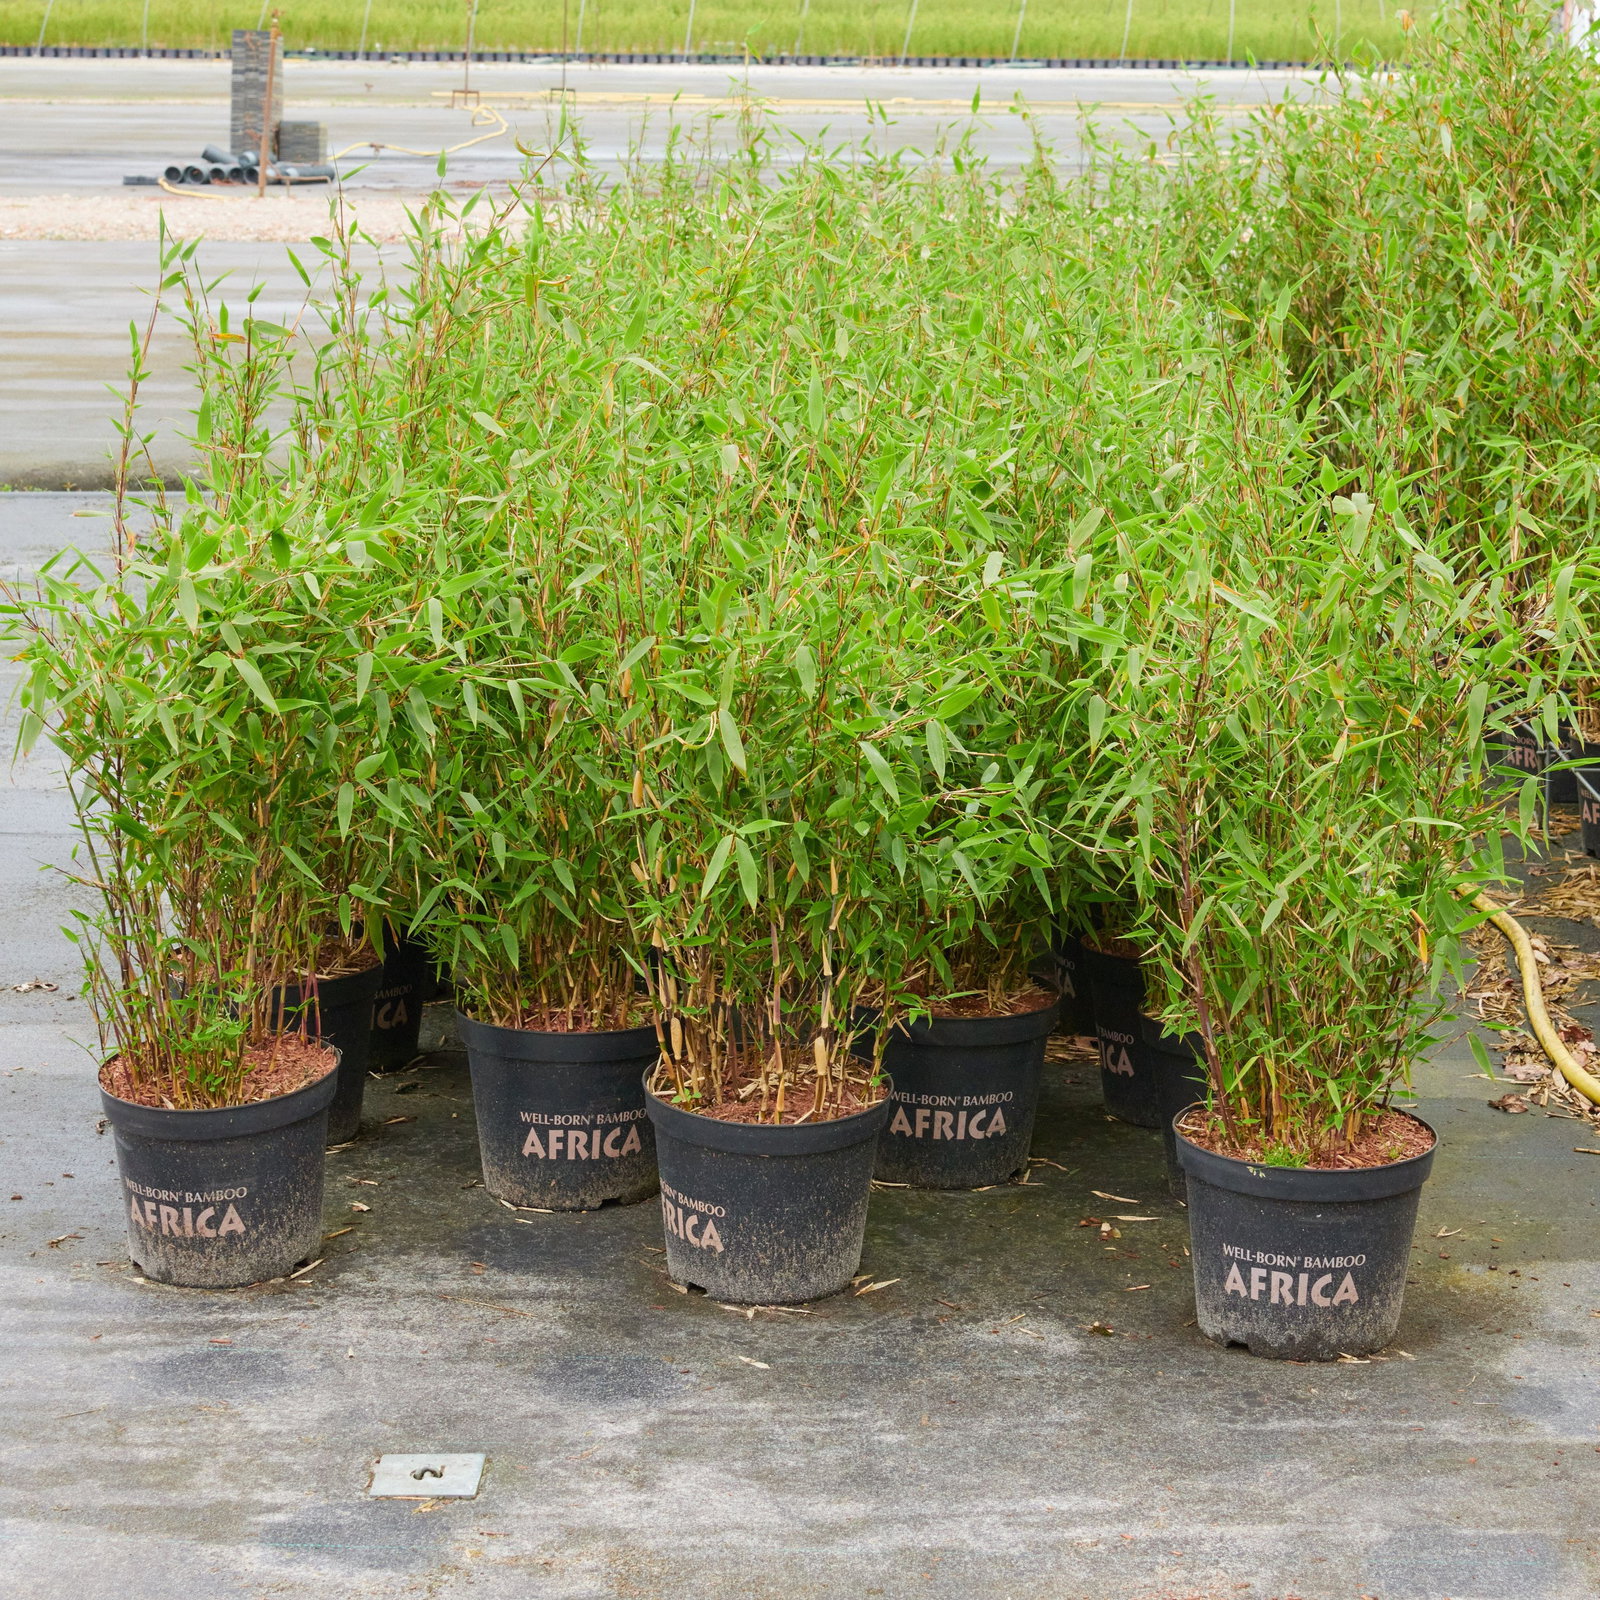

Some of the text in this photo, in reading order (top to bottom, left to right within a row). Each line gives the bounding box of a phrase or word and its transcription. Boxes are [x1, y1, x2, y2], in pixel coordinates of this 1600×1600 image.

[370, 998, 409, 1030] ICA
[1101, 1041, 1136, 1077] ICA
[962, 1091, 1014, 1107] BAMBOO
[597, 1108, 647, 1125] BAMBOO
[889, 1105, 1007, 1140] AFRICA
[521, 1124, 642, 1160] AFRICA
[184, 1186, 248, 1203] BAMBOO
[678, 1192, 726, 1218] BAMBOO
[130, 1195, 247, 1238] AFRICA
[1303, 1254, 1367, 1269] BAMBOO
[1224, 1261, 1360, 1307] AFRICA
